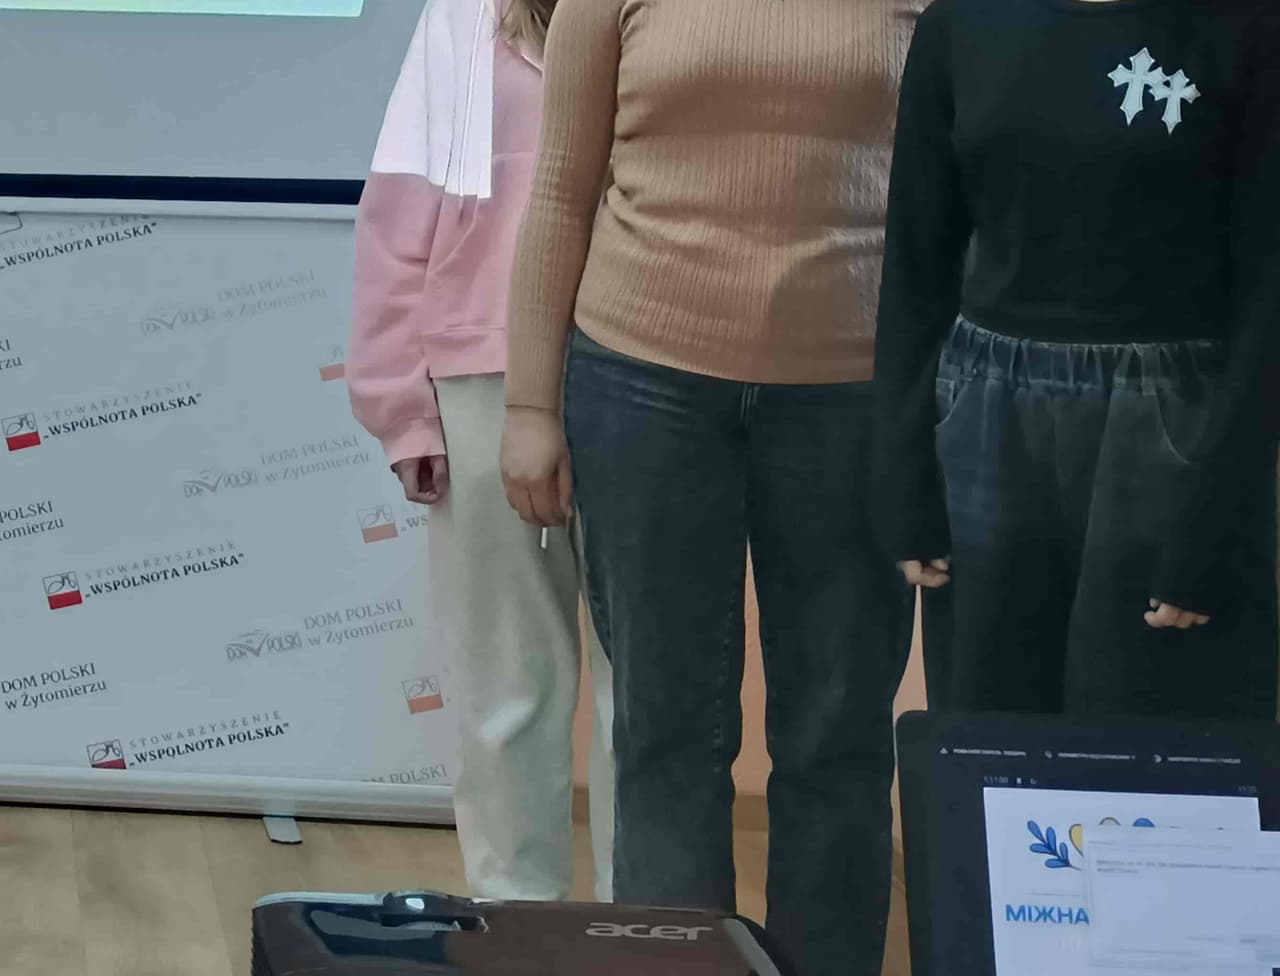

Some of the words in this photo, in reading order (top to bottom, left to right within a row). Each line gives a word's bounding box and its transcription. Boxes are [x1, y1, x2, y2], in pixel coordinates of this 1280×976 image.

[303, 611, 342, 630] DOM
[345, 598, 404, 622] POLSKI
[308, 636, 321, 647] w
[1, 675, 38, 694] DOM
[40, 662, 97, 685] POLSKI
[5, 699, 18, 710] w
[22, 680, 108, 709] Żytomierzu
[585, 922, 713, 940] acer
